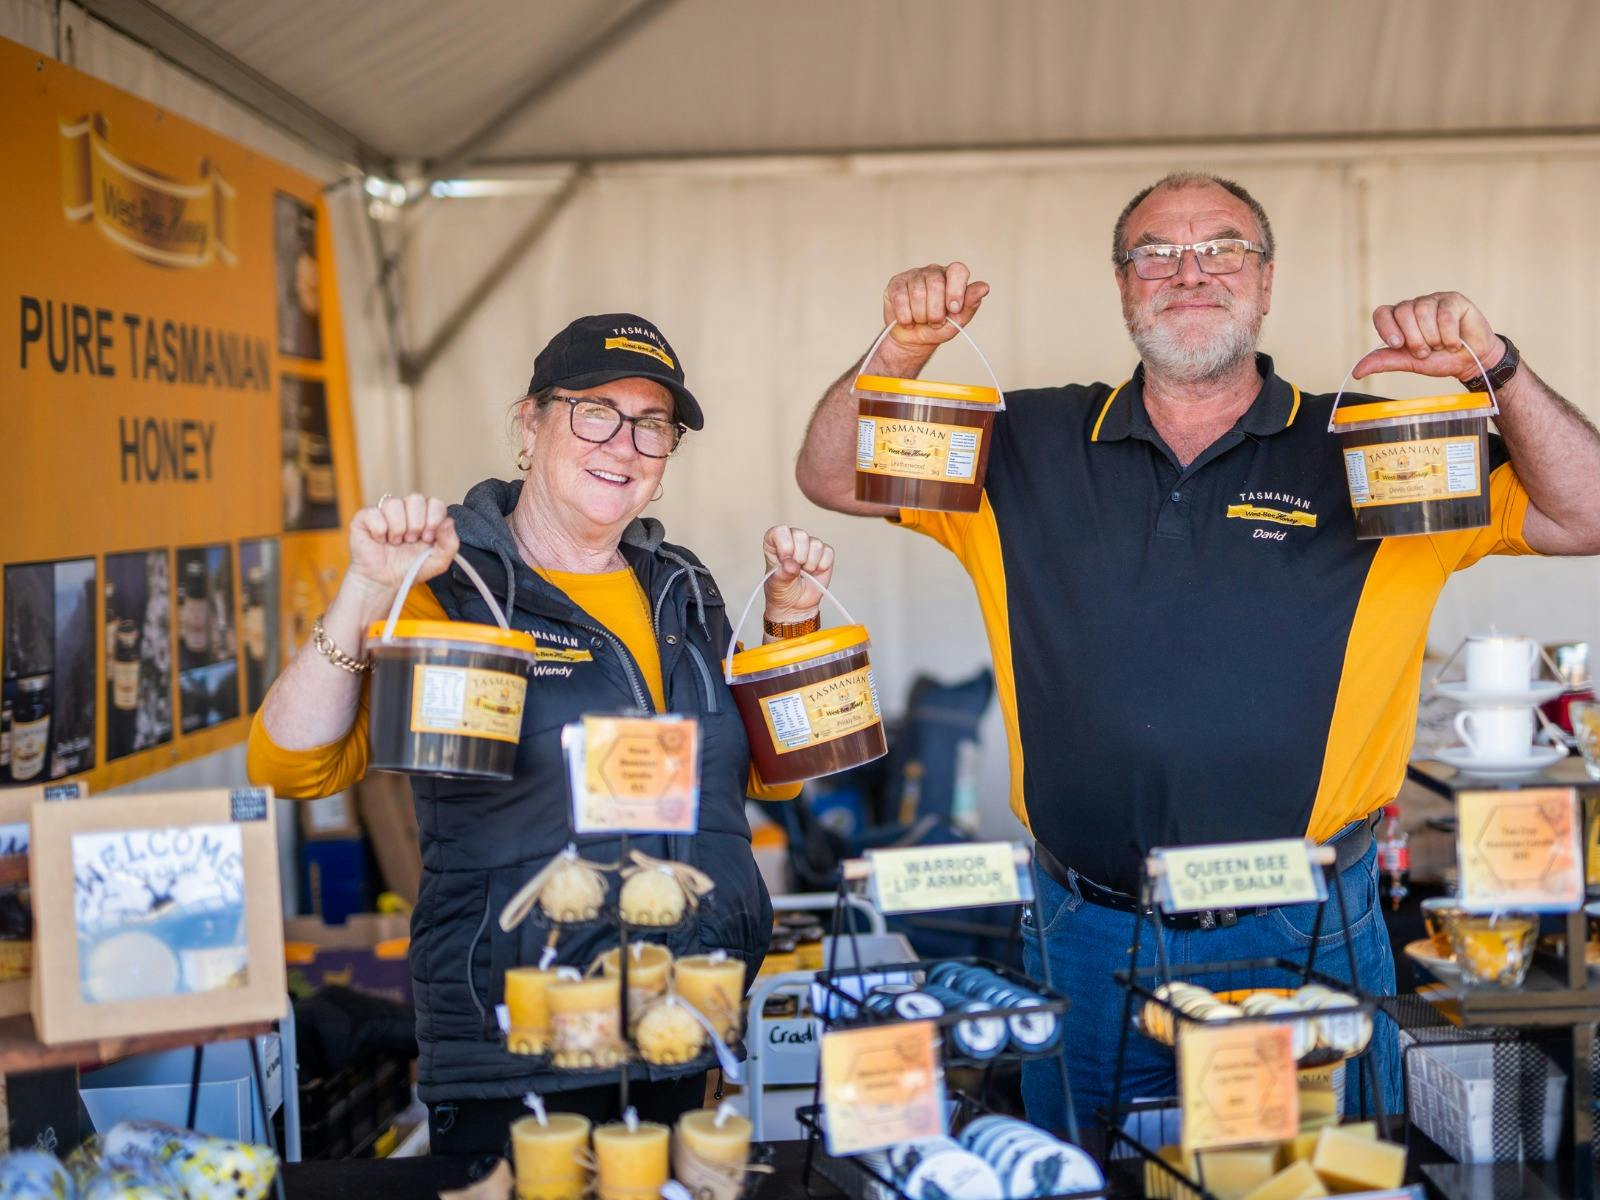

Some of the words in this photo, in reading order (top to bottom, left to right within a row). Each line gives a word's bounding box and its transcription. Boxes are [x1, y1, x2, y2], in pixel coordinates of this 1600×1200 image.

[19, 295, 116, 378] PURE
[123, 313, 271, 392] TASMANIAN
[879, 424, 946, 441] TASMANIAN
[119, 416, 215, 483] HONEY
[1369, 445, 1441, 463] TASMANIAN
[1240, 491, 1311, 509] TASMANIAN
[1252, 528, 1287, 541] David
[524, 630, 578, 647] MANIAN
[533, 665, 573, 678] Wendy
[809, 675, 867, 703] TASMANIAN
[74, 829, 242, 894] WELCOME
[904, 856, 986, 874] WARRIOR
[1184, 858, 1250, 879] QUEEN
[1254, 855, 1289, 871] BEE
[894, 878, 921, 893] LIP
[927, 872, 1002, 889] ARMOUR
[1200, 880, 1230, 895] LIP
[1234, 874, 1285, 891] BALM
